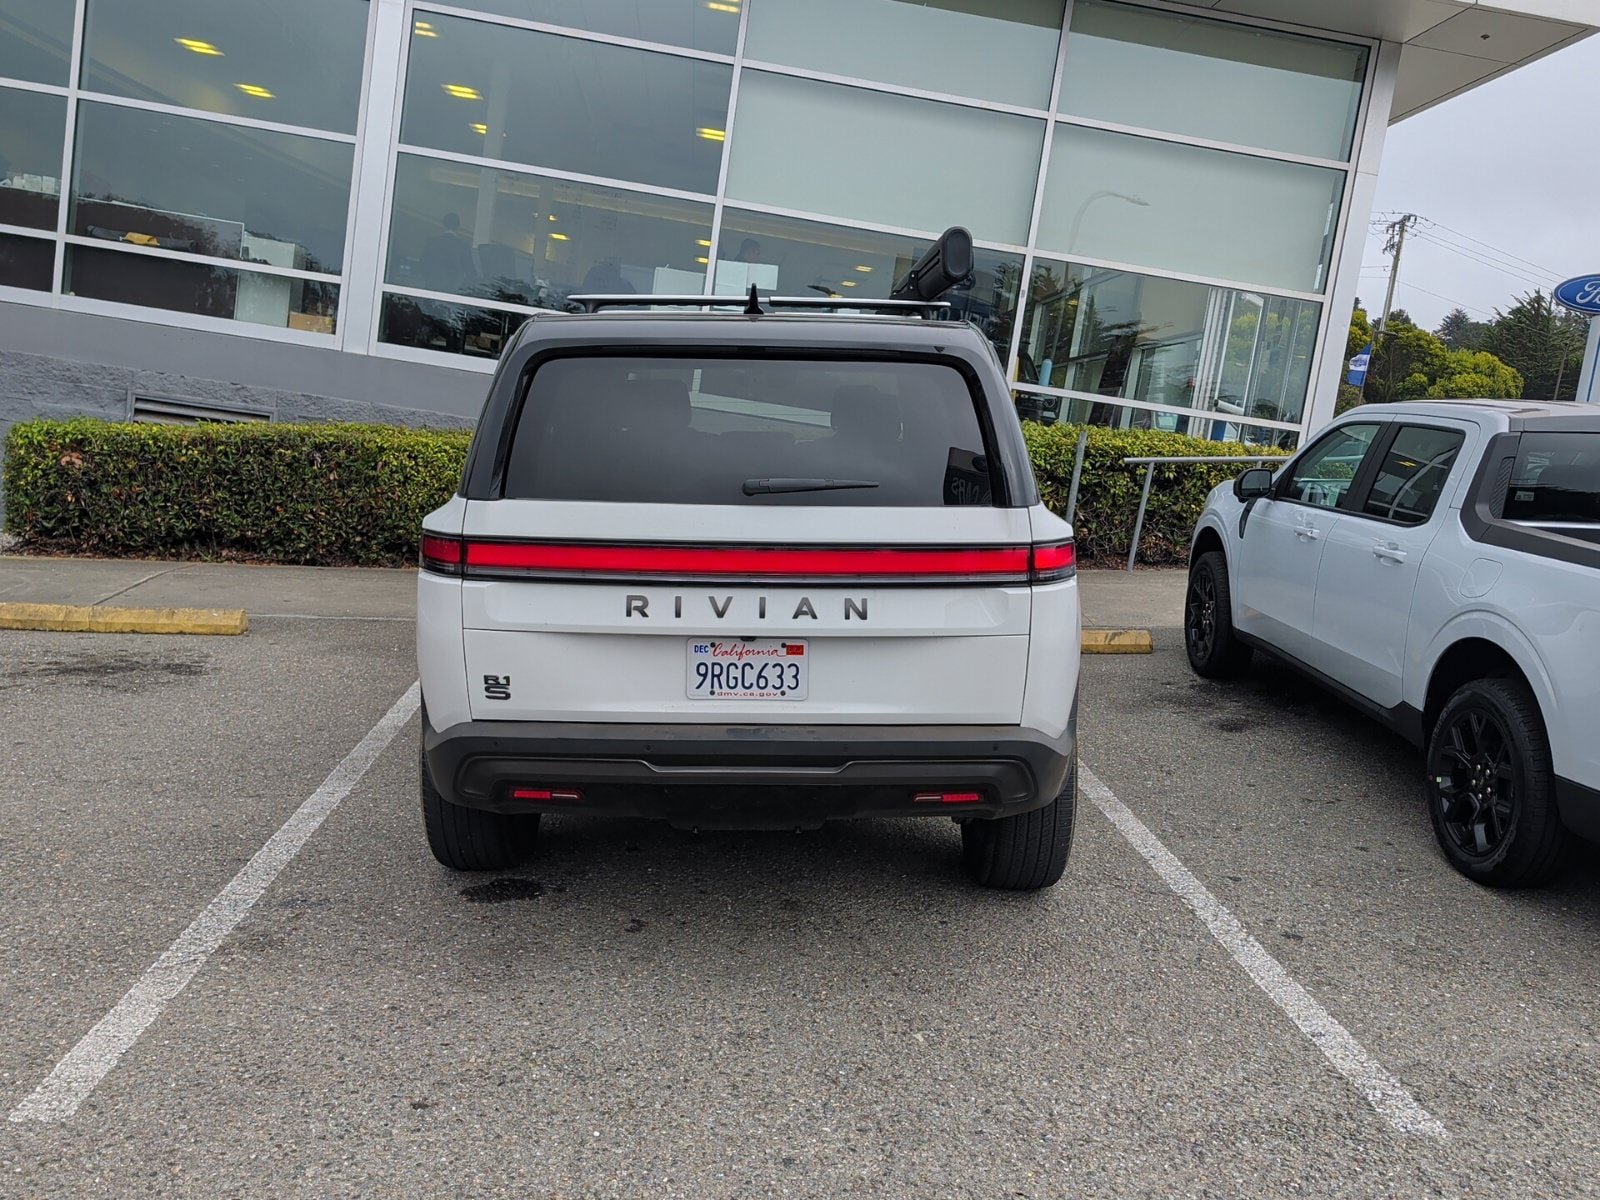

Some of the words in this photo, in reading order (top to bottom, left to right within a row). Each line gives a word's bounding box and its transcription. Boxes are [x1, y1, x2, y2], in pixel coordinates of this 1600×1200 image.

[625, 594, 868, 621] RIVIAN
[694, 644, 709, 653] DEC
[712, 642, 784, 661] California
[695, 661, 800, 690] 9RGC633
